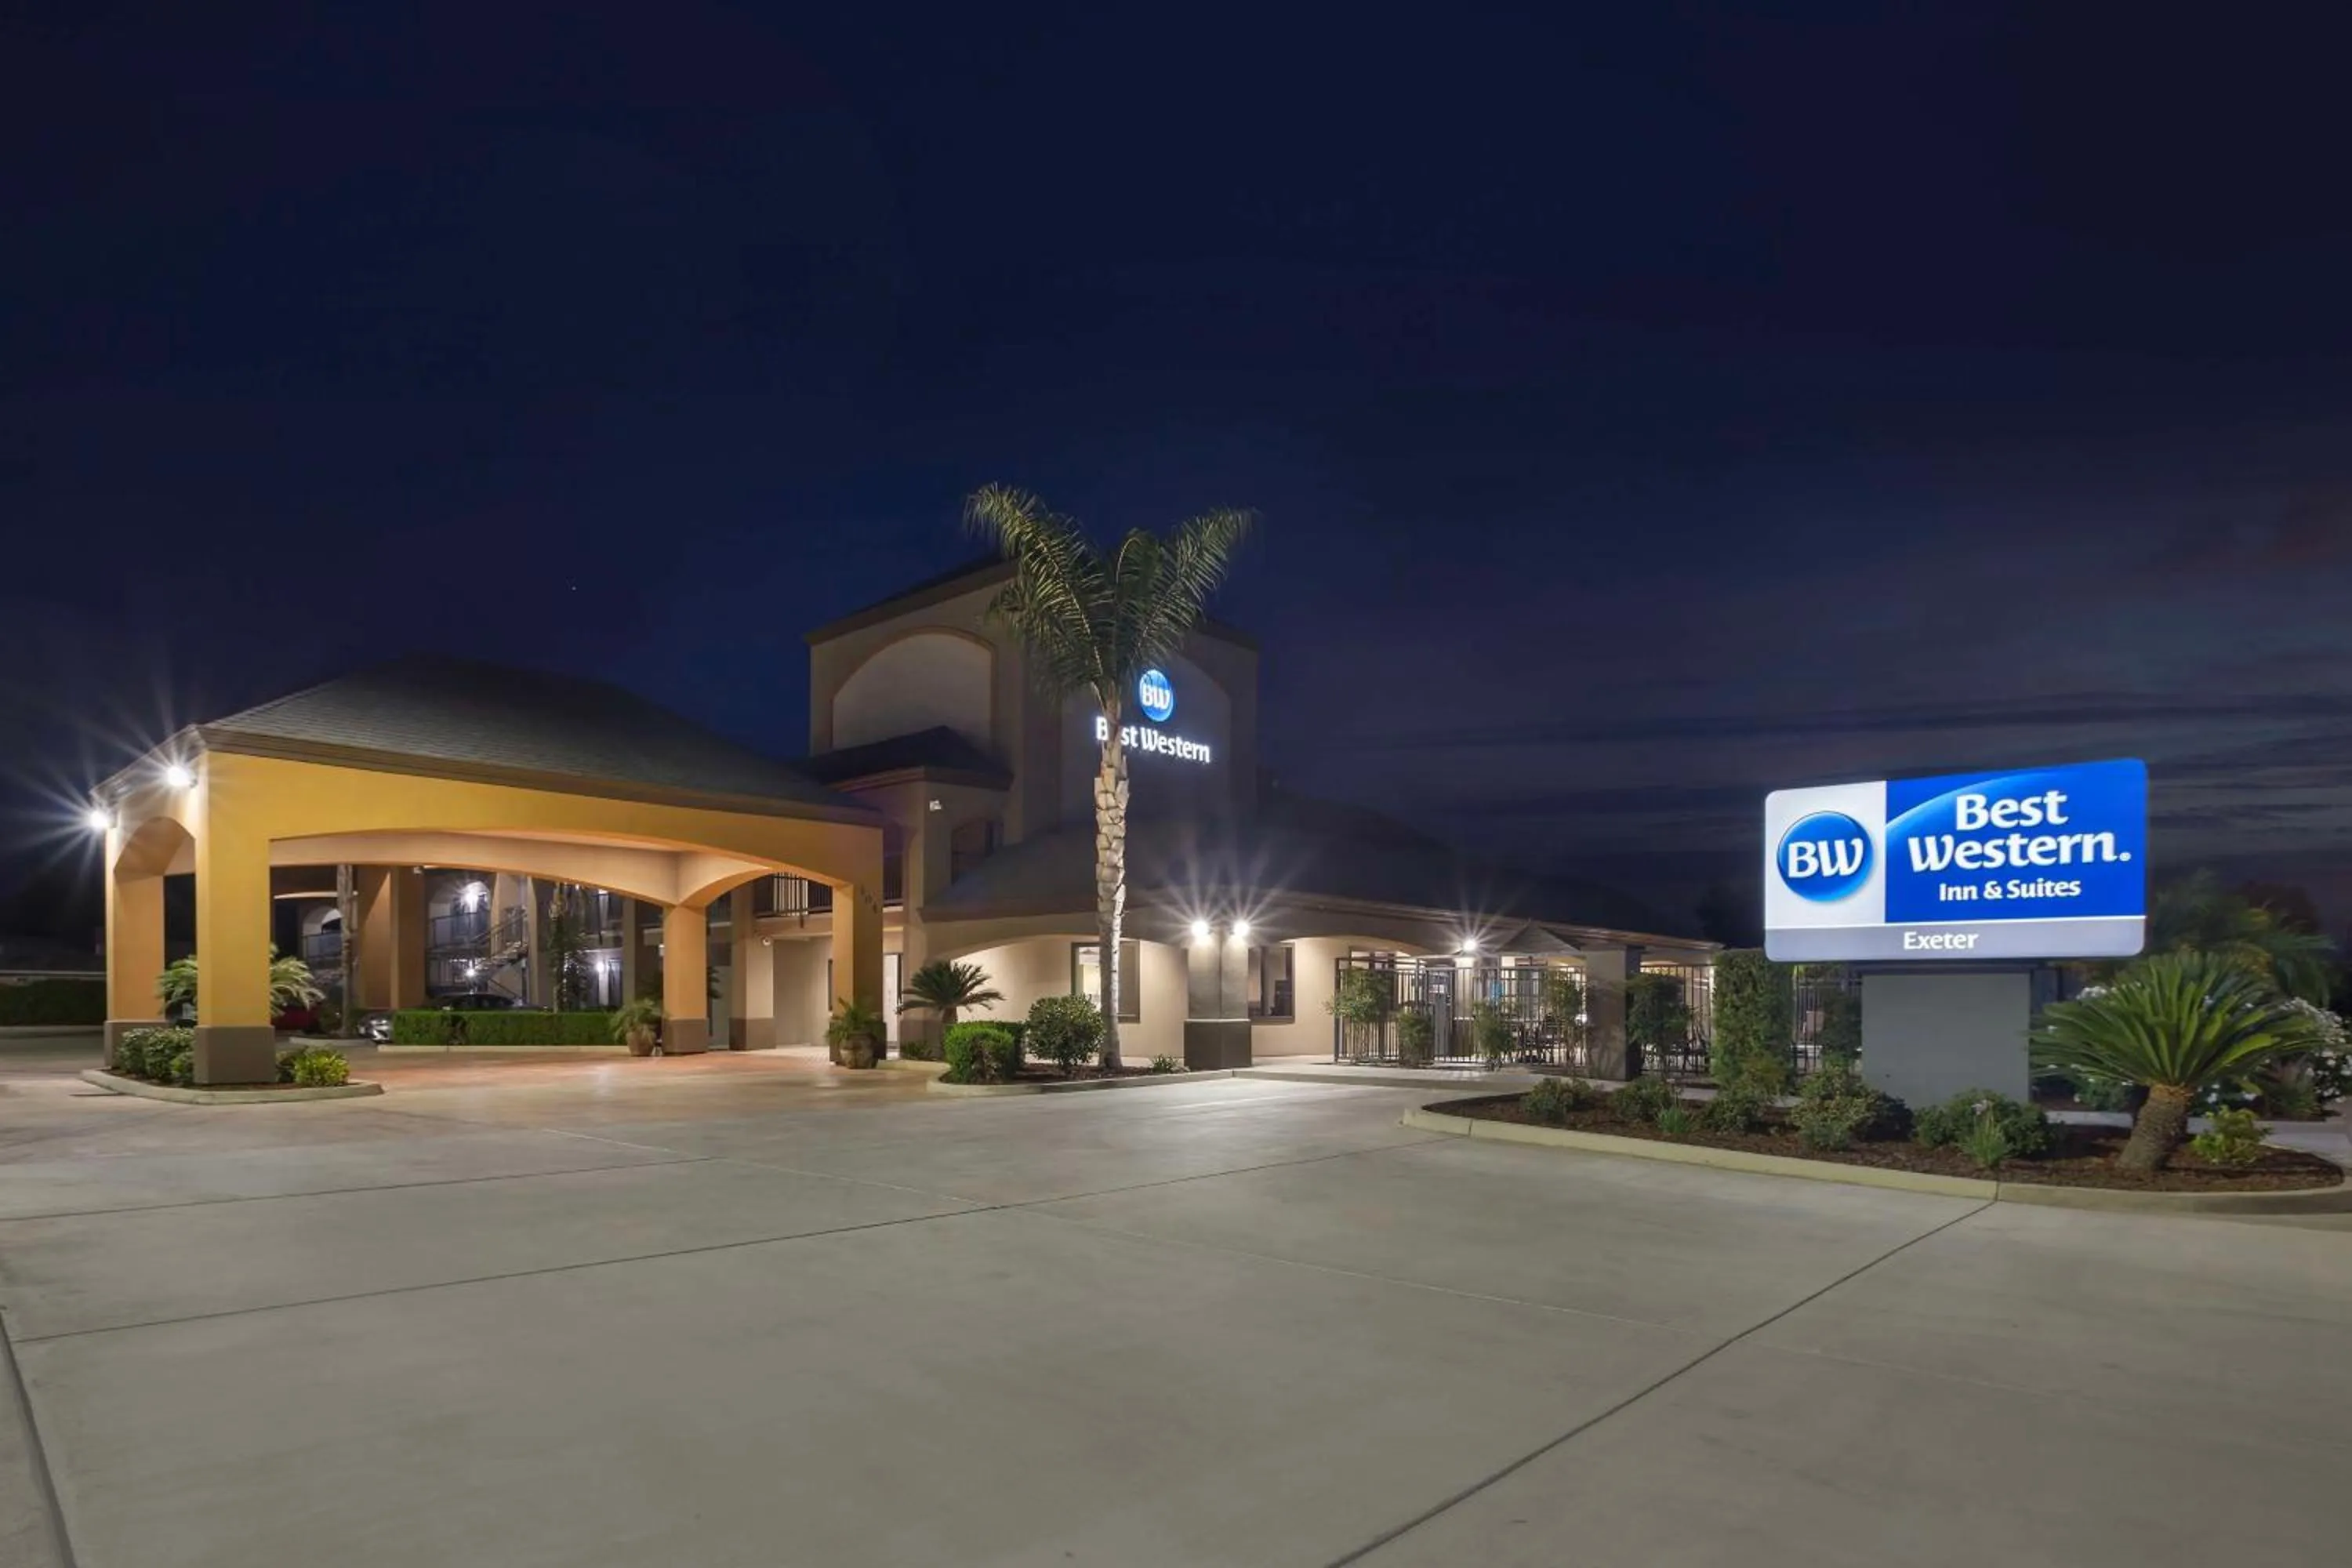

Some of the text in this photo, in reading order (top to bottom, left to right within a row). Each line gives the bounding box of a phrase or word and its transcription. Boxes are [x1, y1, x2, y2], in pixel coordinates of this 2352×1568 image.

[1142, 684, 1171, 710] BW
[1096, 717, 1210, 763] Bst Western
[1956, 790, 2068, 830] Best
[1788, 838, 1863, 878] BW
[1940, 877, 2081, 901] Inn & Suites
[1904, 931, 1979, 949] Exeter
